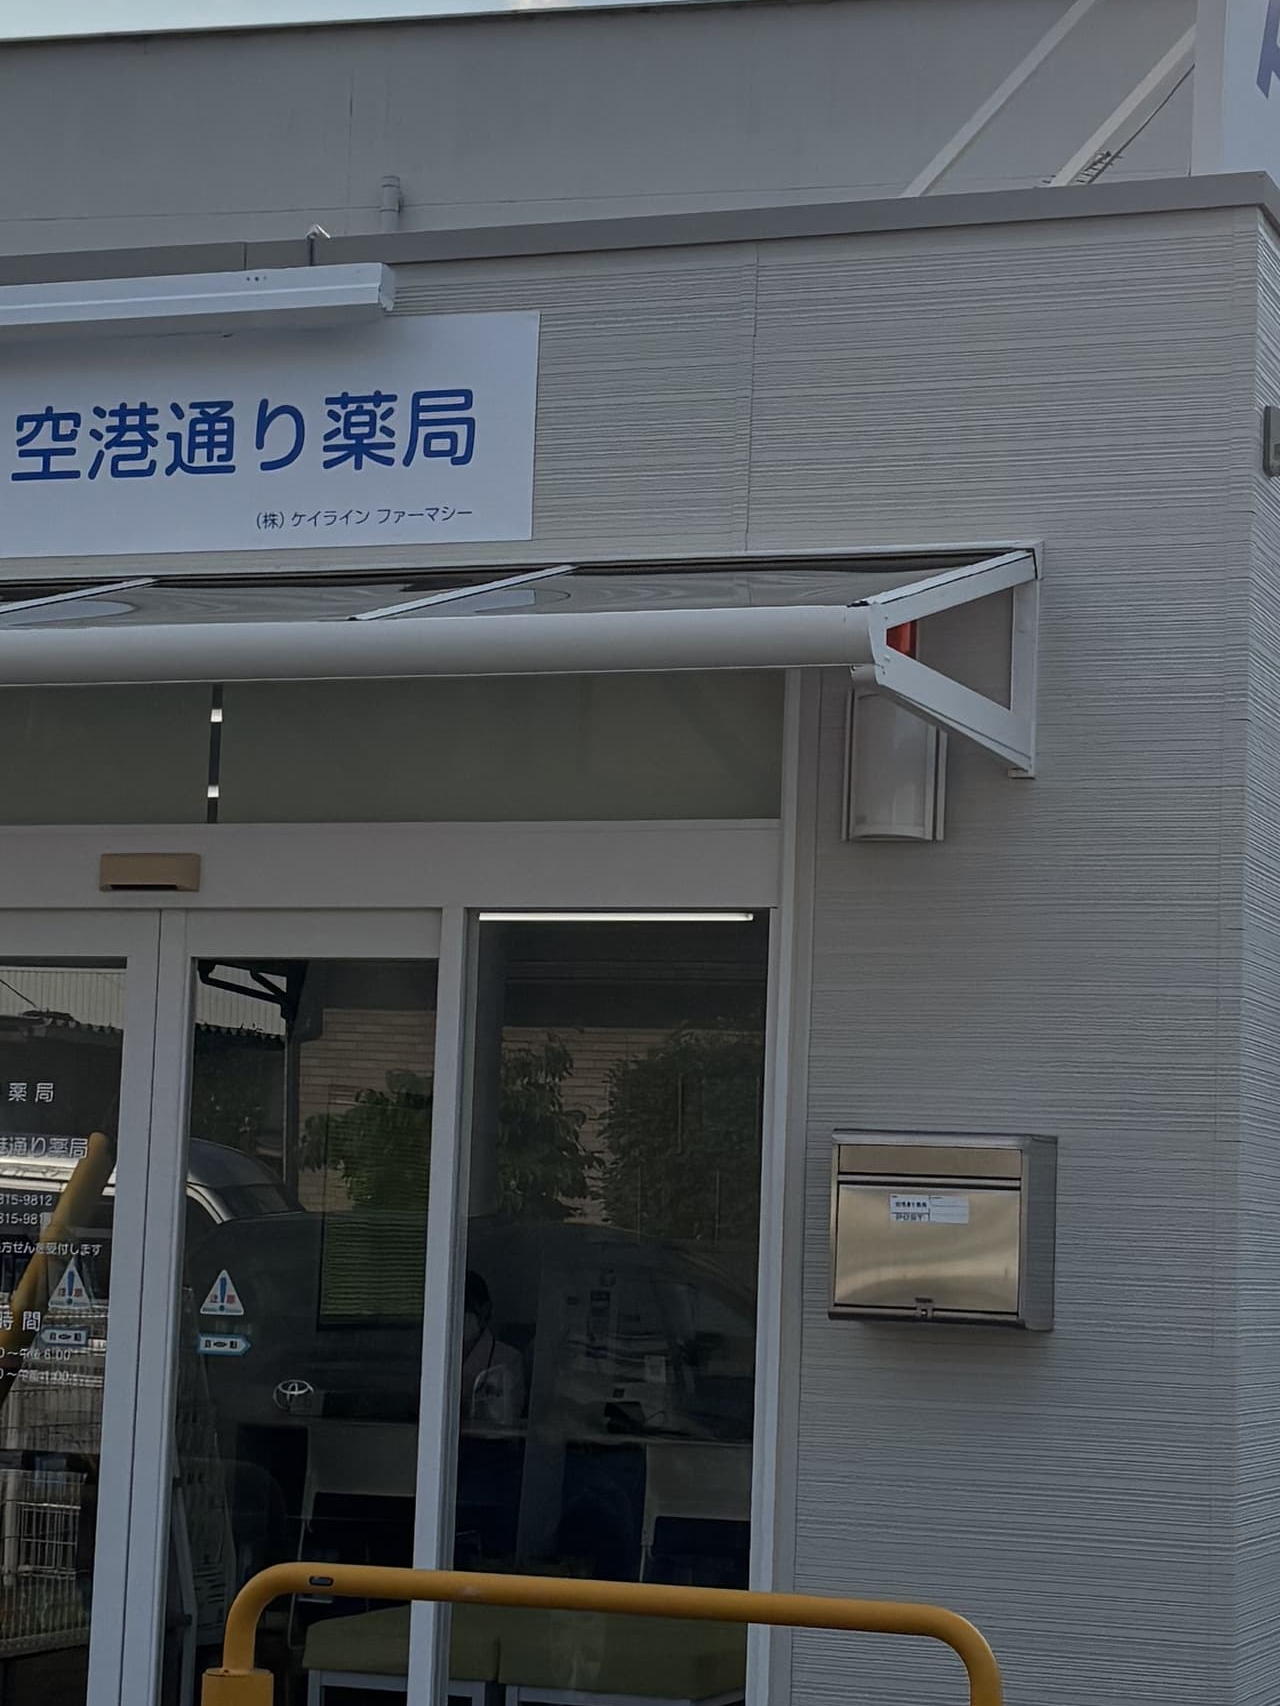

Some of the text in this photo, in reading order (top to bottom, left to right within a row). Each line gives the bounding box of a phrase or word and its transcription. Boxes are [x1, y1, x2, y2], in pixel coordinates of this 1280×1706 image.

[11, 389, 476, 481] 空港通り薬局
[291, 509, 370, 528] ケイライン
[377, 505, 473, 525] ファーマシー
